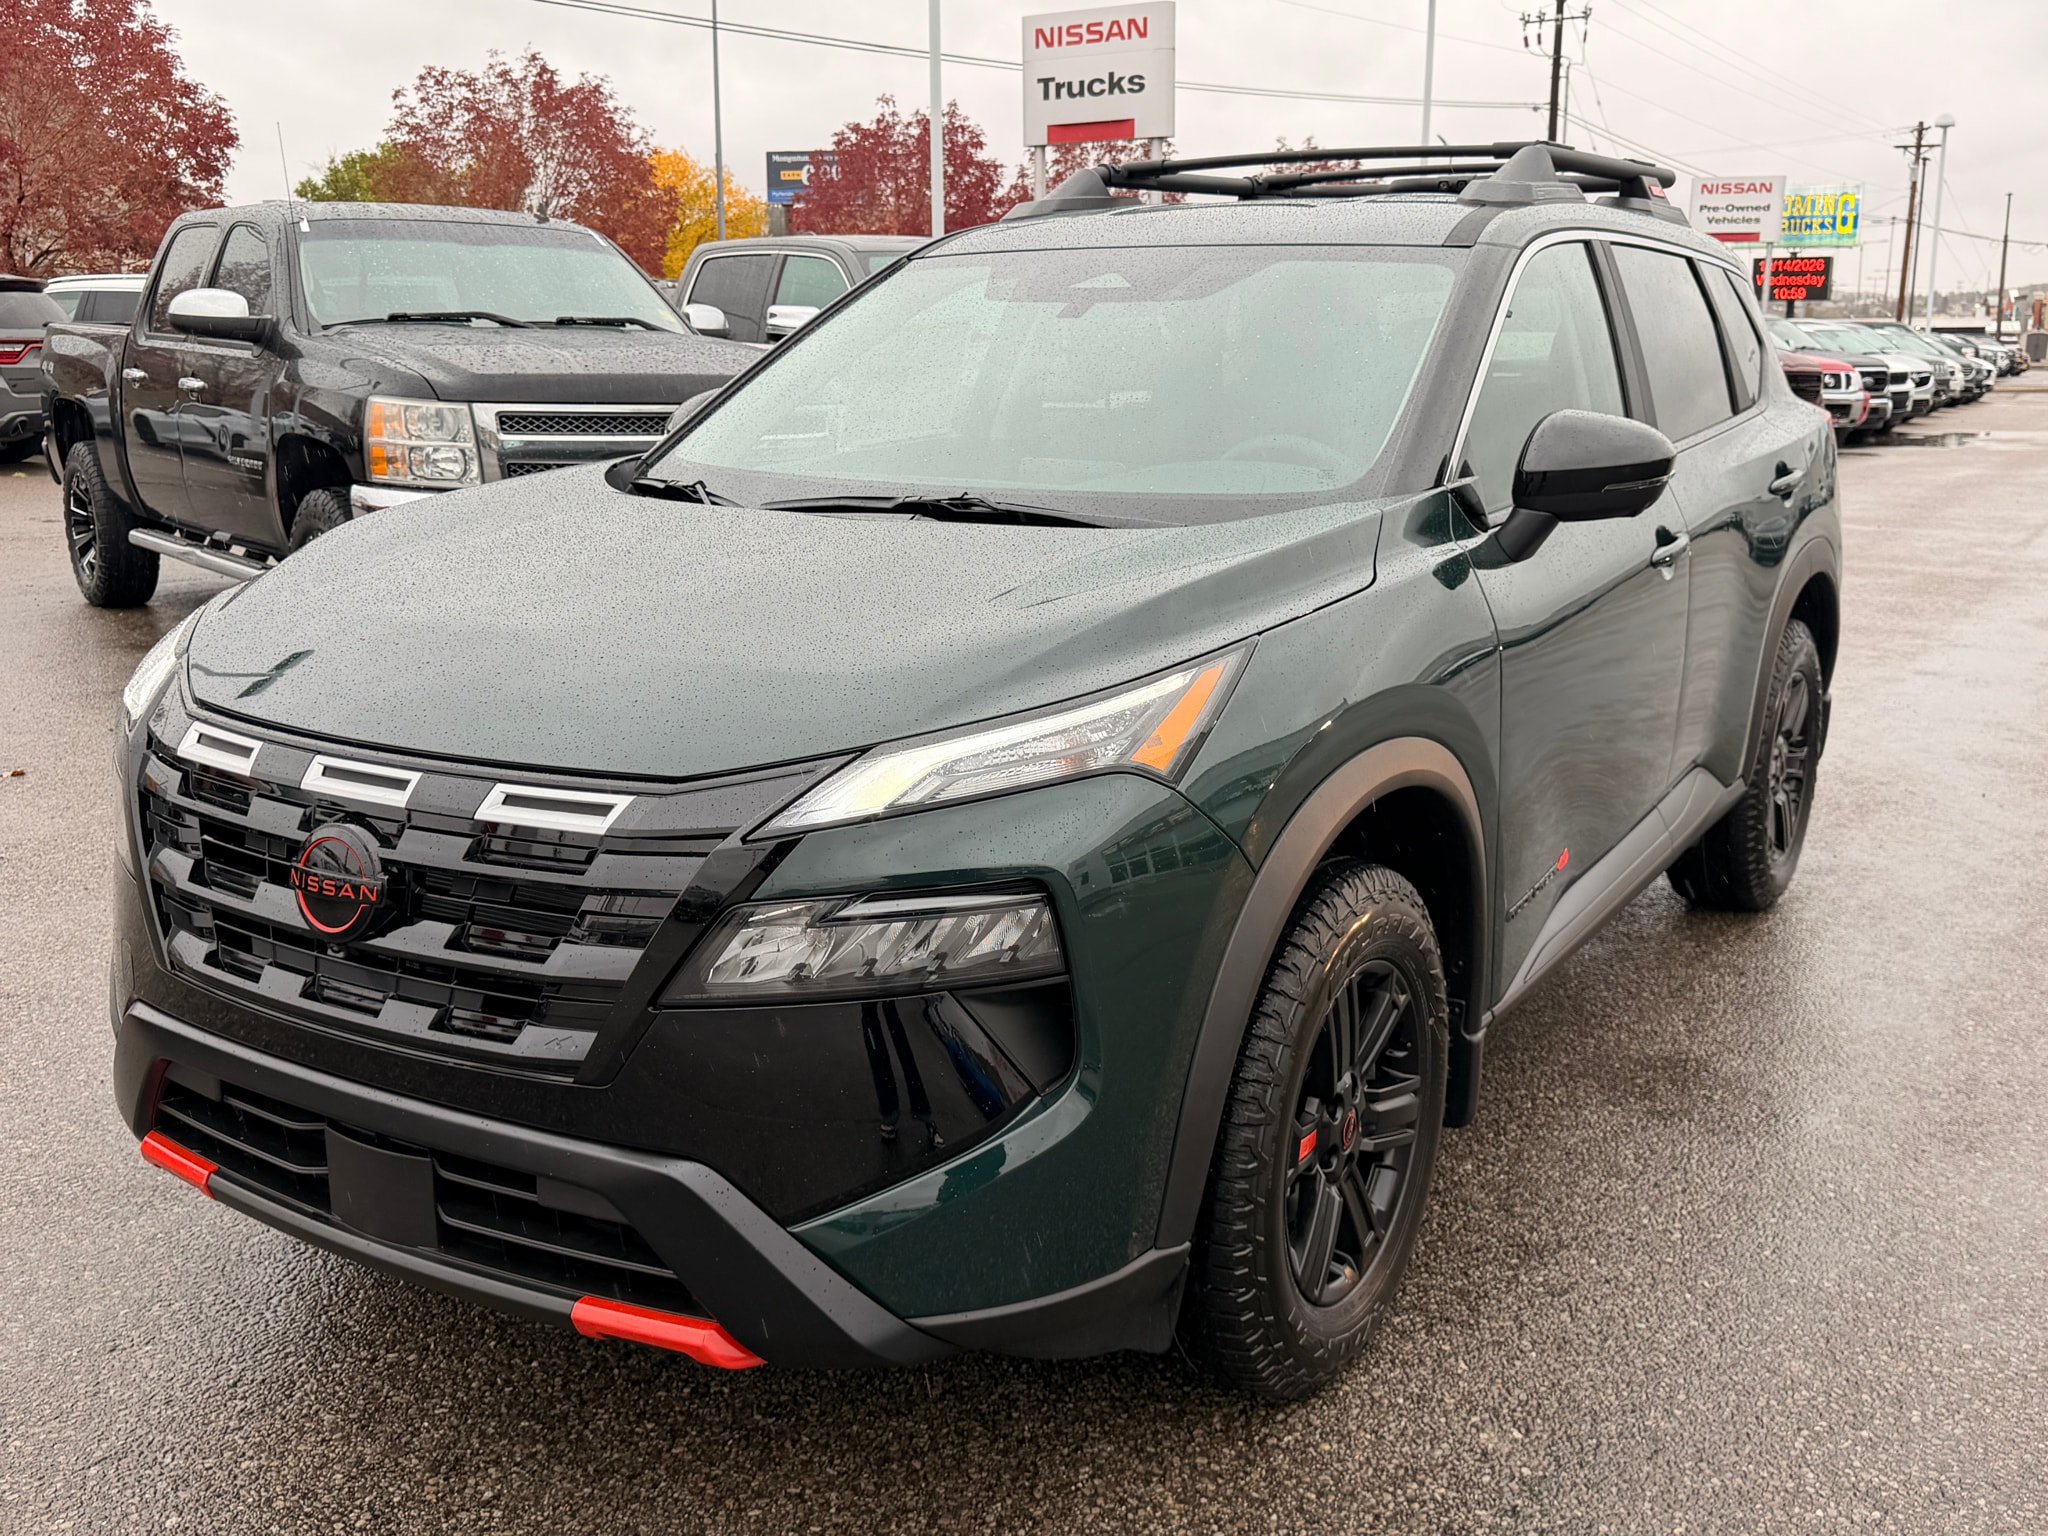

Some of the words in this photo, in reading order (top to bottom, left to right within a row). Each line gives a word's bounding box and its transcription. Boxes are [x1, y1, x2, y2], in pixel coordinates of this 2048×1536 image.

[1034, 16, 1148, 49] NISSAN
[1037, 71, 1146, 101] Trucks
[1700, 181, 1773, 195] NISSAN
[1699, 203, 1771, 212] Pre-Owned
[1706, 216, 1761, 225] Vehicles
[1773, 287, 1807, 300] 10:59
[290, 867, 378, 902] NISSAN
